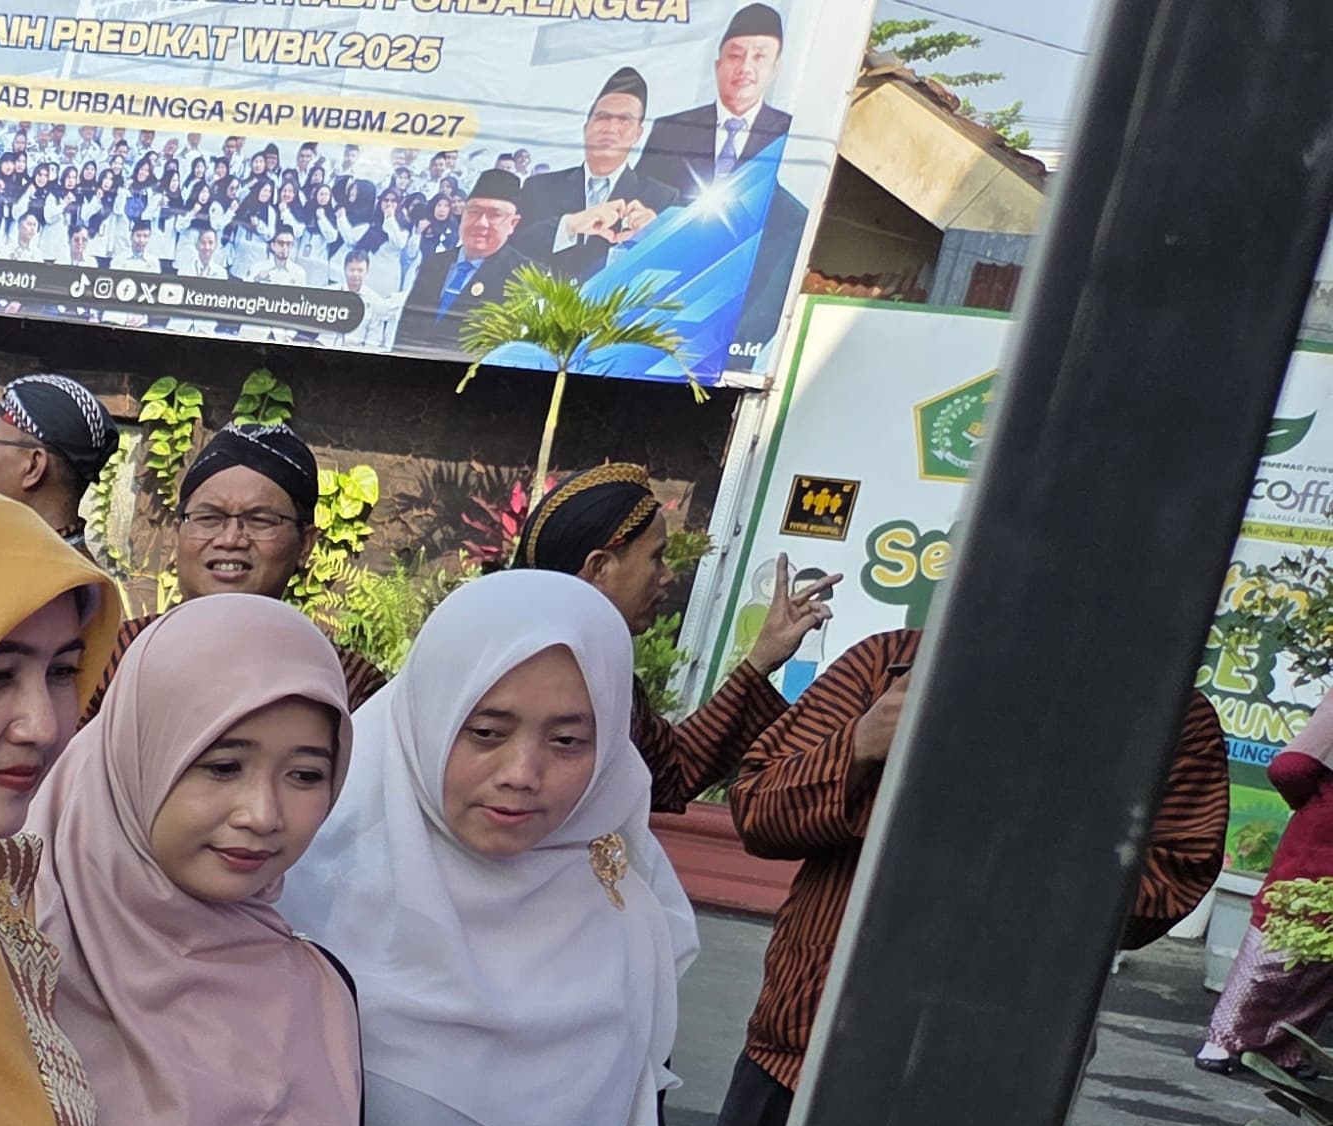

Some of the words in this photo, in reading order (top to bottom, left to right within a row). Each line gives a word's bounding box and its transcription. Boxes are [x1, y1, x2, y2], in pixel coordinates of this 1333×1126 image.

[51, 17, 238, 61] PREDIKAT
[243, 27, 336, 67] WBK
[335, 32, 444, 73] 2025
[40, 88, 224, 123] PURBALINGGA
[233, 101, 294, 125] SIAP
[302, 106, 386, 131] WBBM
[391, 112, 465, 138] 2027
[185, 288, 349, 322] KemenagPurbalingga
